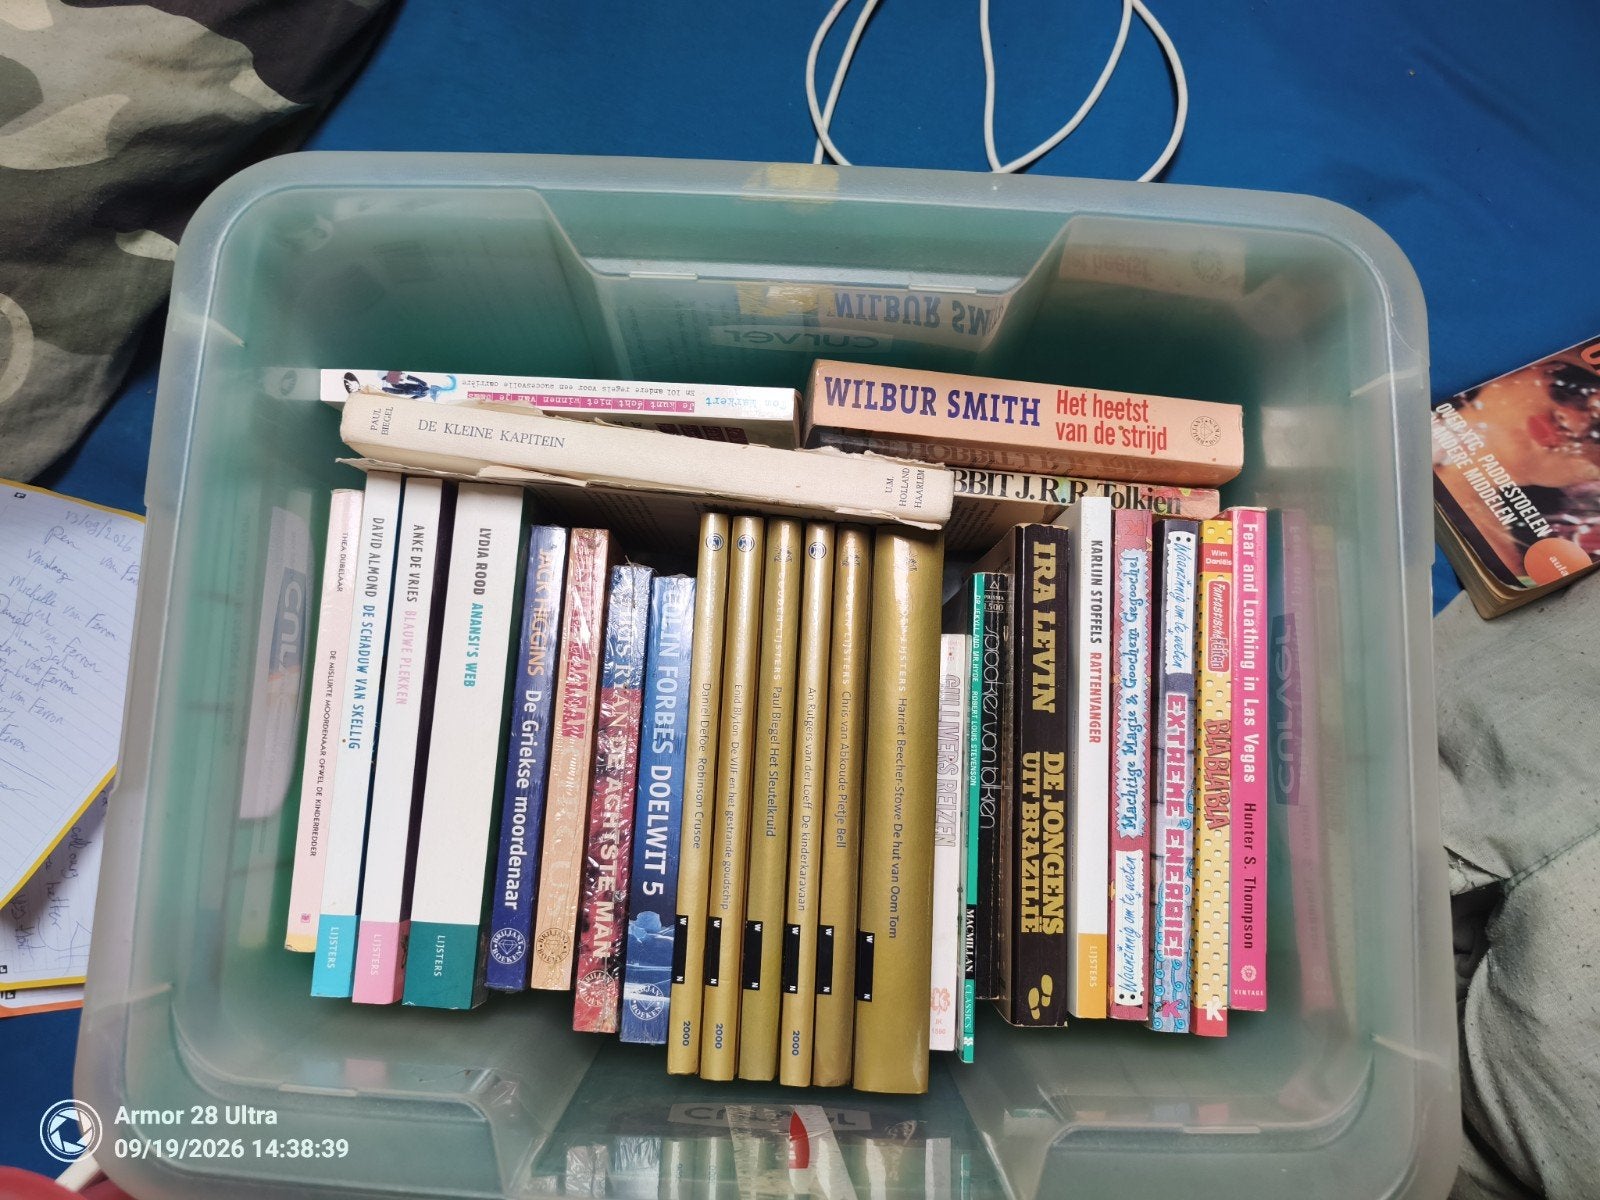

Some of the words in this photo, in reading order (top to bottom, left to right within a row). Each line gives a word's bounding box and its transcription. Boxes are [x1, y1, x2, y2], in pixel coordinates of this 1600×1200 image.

[370, 407, 382, 431] PAUL
[824, 375, 938, 419] WILBUR
[947, 388, 1041, 428] SMITH
[1055, 388, 1088, 418] Het
[1092, 397, 1150, 425] heetst
[381, 406, 394, 436] BIEGEL
[418, 418, 438, 433] DE
[443, 422, 494, 440] KLEINE
[499, 429, 566, 449] KAPITEIN
[1055, 420, 1088, 445] van
[1093, 417, 1116, 447] de
[1119, 424, 1169, 456] strijd
[898, 467, 910, 507] HOLLAND
[913, 469, 926, 509] HAARLEM
[1434, 402, 1467, 432] OVER
[1477, 453, 1554, 539] PADDESTOELEN
[339, 531, 349, 553] THEA
[370, 516, 386, 550] DAVID
[411, 524, 426, 554] ANKE
[476, 527, 492, 559] LYDIA
[1242, 523, 1259, 557] Fear
[336, 552, 347, 593] DUBELAAR
[410, 555, 422, 569] DE
[1032, 541, 1057, 604] IRA
[1090, 539, 1103, 586] KARLIJN
[1210, 549, 1229, 558] Wim
[1549, 554, 1570, 578] aula
[364, 551, 381, 599] ALMOND
[405, 571, 421, 603] VRIES
[472, 561, 488, 596] ROOD
[1124, 556, 1144, 623] Gegoochel
[1168, 542, 1192, 606] Waanzinnig
[1242, 564, 1259, 593] and
[362, 603, 376, 619] DE
[658, 590, 682, 660] COLIN
[1089, 588, 1103, 645] STOFFELS
[1175, 617, 1190, 634] te
[1176, 601, 1186, 618] om
[1212, 582, 1227, 640] Fantastische
[356, 619, 373, 675] SCHADUW
[399, 610, 417, 657] BLAUWE
[465, 602, 484, 658] ANANSI'S
[526, 598, 552, 677] HIGGINS
[1239, 599, 1260, 670] Loathing
[842, 632, 853, 686] LIJSTERS
[898, 639, 908, 693] LIJSTERS
[1032, 609, 1057, 714] LEVIN
[1121, 628, 1141, 690] Goochem
[1171, 633, 1191, 670] weten
[1209, 636, 1230, 670] Feiten
[325, 662, 336, 698] MISLUKTE
[352, 675, 369, 701] VAN
[395, 656, 412, 705] PLEKKEN
[463, 662, 479, 688] WEB
[971, 663, 980, 683] HYDE
[1243, 676, 1260, 692] in
[523, 688, 543, 714] De
[608, 662, 632, 729] RYAN
[651, 665, 680, 755] FORBES
[700, 682, 712, 719] Daniel
[734, 684, 744, 705] Enid
[772, 686, 784, 709] Paul
[840, 691, 853, 718] Chris
[970, 691, 979, 719] ROBERT
[1088, 651, 1103, 743] RATTENVANGER
[1243, 698, 1260, 727] Las
[319, 698, 332, 756] MOORDENAAR
[347, 702, 365, 750] SKELLIG
[730, 705, 743, 739] Blyton
[769, 710, 782, 746] Biegel
[803, 704, 818, 742] Rutgers
[839, 722, 849, 741] van
[896, 697, 908, 736] Harriet
[970, 720, 979, 742] LOUIS
[1122, 710, 1143, 756] Magie
[515, 719, 541, 789] Griekse
[698, 719, 711, 753] Defoe
[804, 743, 814, 763] van
[982, 721, 999, 764] van
[1203, 718, 1232, 757] BLA
[316, 757, 326, 784] OFWEL
[769, 747, 781, 769] Het
[803, 765, 813, 783] der
[837, 742, 851, 791] Abkoude
[969, 743, 978, 787] STEVENSON
[1021, 751, 1041, 798] UIT
[1043, 751, 1065, 791] DE
[1165, 693, 1188, 818] EXTREME
[1203, 756, 1230, 793] BLA
[1239, 732, 1260, 784] Vegas
[695, 757, 708, 809] Robinson
[802, 784, 814, 810] Loeff
[893, 738, 908, 821] Beecher-Stowe
[1122, 761, 1143, 830] Machtige
[727, 789, 739, 809] het
[765, 769, 781, 838] Sleutelkruid
[834, 793, 848, 826] Pietje
[934, 778, 959, 848] REIZEN
[1203, 791, 1231, 831] BLA
[308, 798, 323, 858] KINDERREDDER
[597, 776, 623, 893] ACHTSTE
[644, 765, 673, 875] DOELWIT
[693, 810, 705, 850] Crusoe
[724, 810, 736, 859] gestrande
[801, 814, 812, 830] De
[836, 827, 848, 849] Bell
[892, 822, 904, 839] De
[1243, 802, 1257, 851] Hunter
[503, 795, 529, 911] moordenaar
[891, 840, 904, 861] hut
[1041, 794, 1065, 935] JONGENS
[1243, 855, 1257, 870] S.
[642, 881, 665, 896] 5
[719, 860, 732, 911] goudschip
[797, 831, 812, 912] kinderkaravaan
[890, 863, 900, 884] van
[1125, 855, 1138, 888] weten
[888, 886, 901, 914] Oom
[1122, 889, 1135, 905] te
[1163, 827, 1186, 958] ENERGIE!
[592, 900, 615, 959] MAN
[888, 914, 900, 940] Tom
[1124, 907, 1135, 924] om
[1240, 876, 1257, 950] Thompson
[964, 908, 976, 974] MACMILLAN
[1118, 926, 1141, 994] Waanzinnig
[964, 983, 973, 1029] CLASSICS
[1233, 988, 1265, 997] VINTAGE
[682, 1020, 692, 1047] 2000
[715, 1022, 724, 1050] 2000
[791, 1029, 801, 1057] 2000
